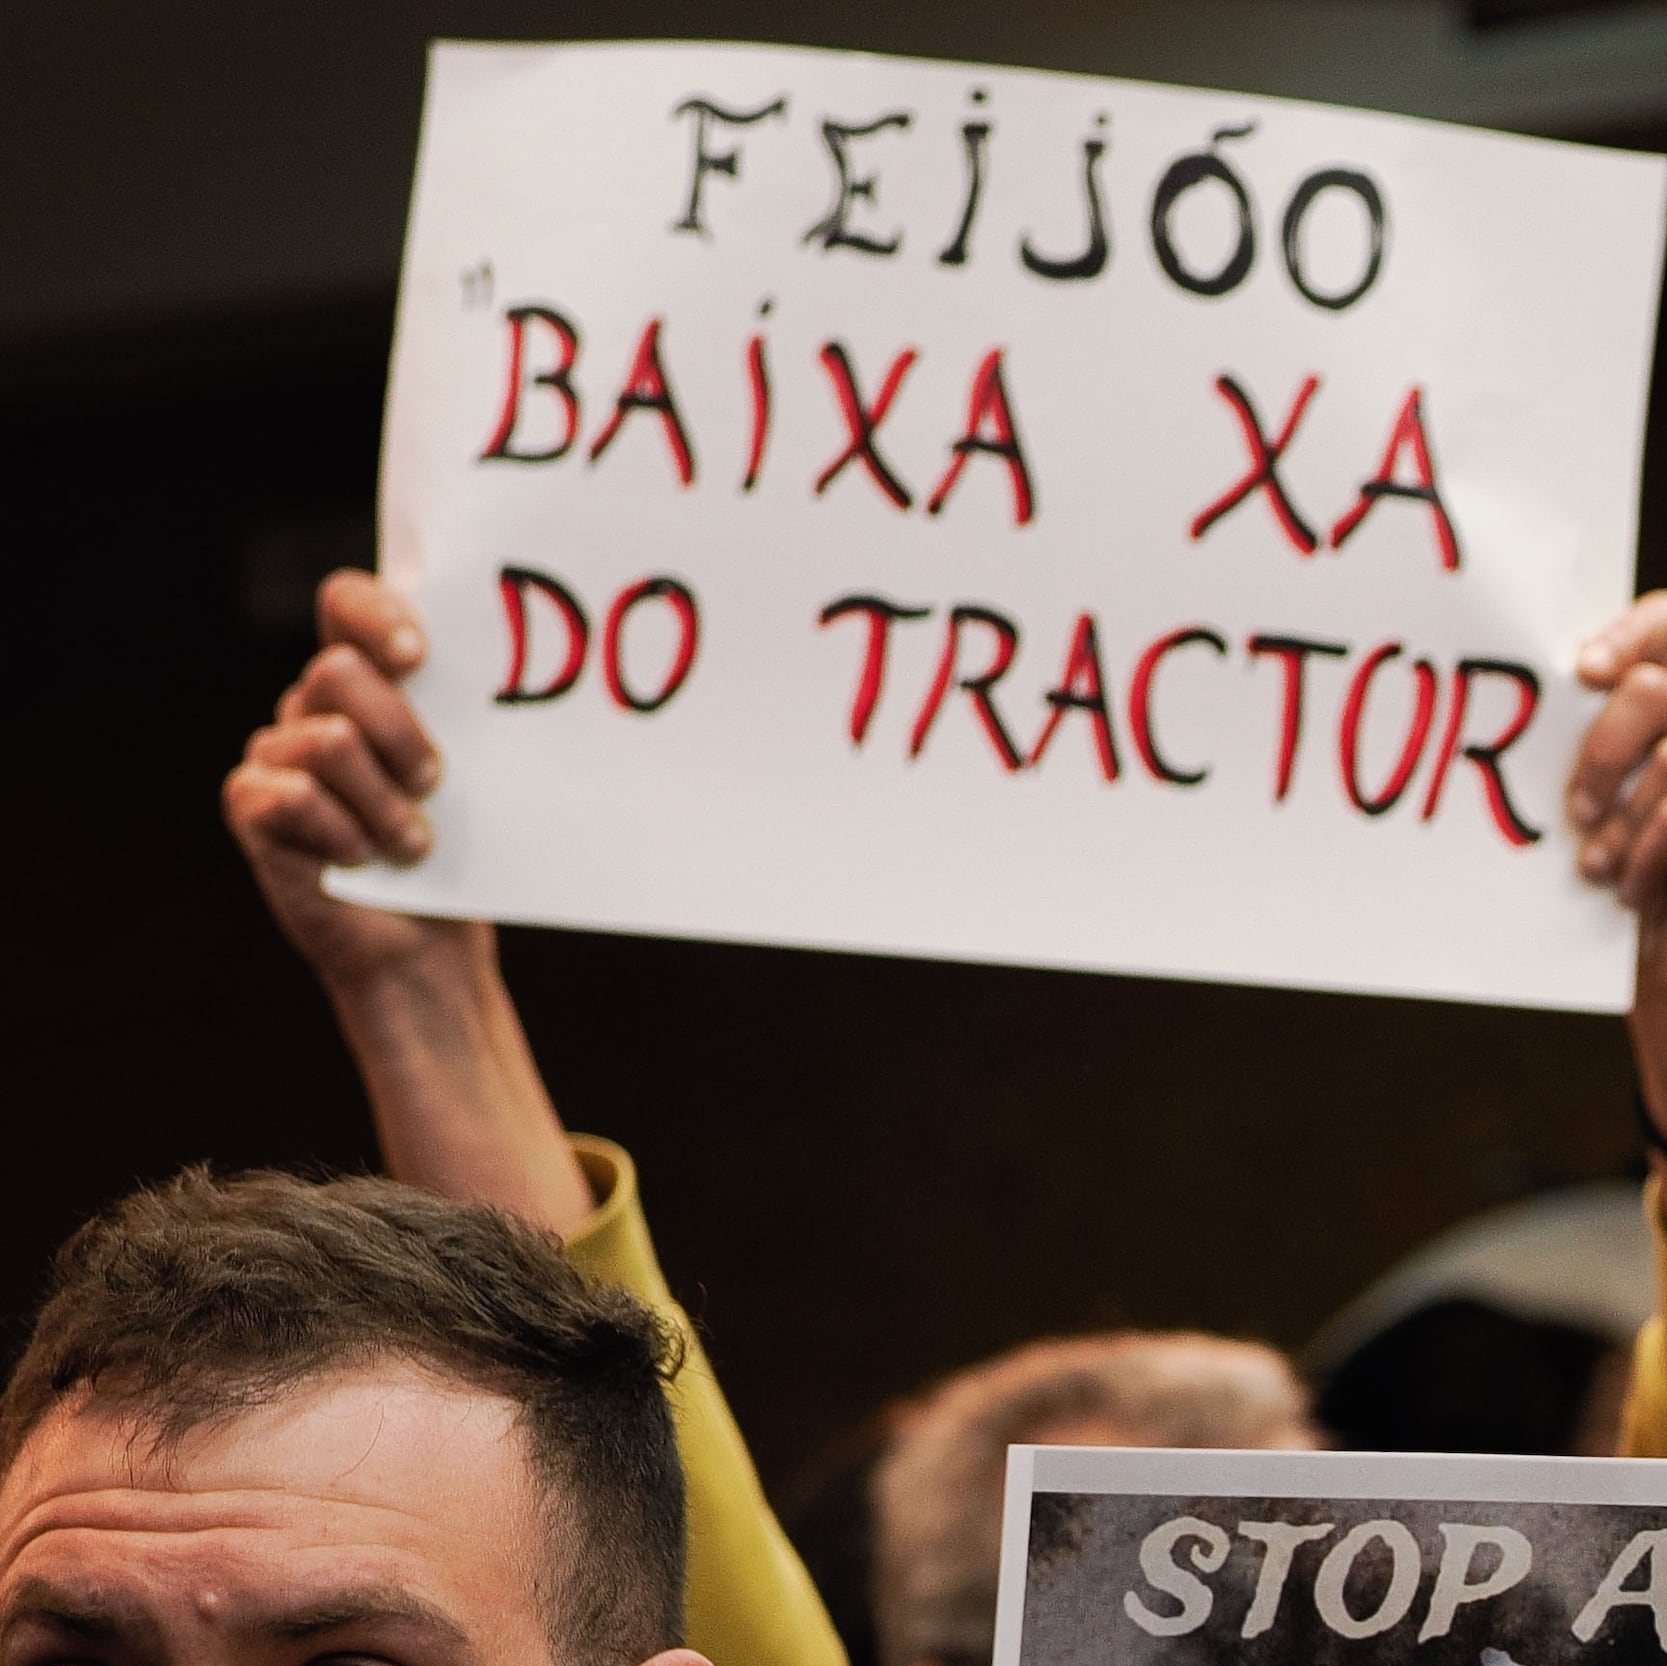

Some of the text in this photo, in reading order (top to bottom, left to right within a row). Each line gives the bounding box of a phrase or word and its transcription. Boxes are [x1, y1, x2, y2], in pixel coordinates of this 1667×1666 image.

[1188, 372, 1463, 574] XA
[491, 562, 1546, 850] DO TRACTOR
[1122, 1516, 1533, 1646] STOP
